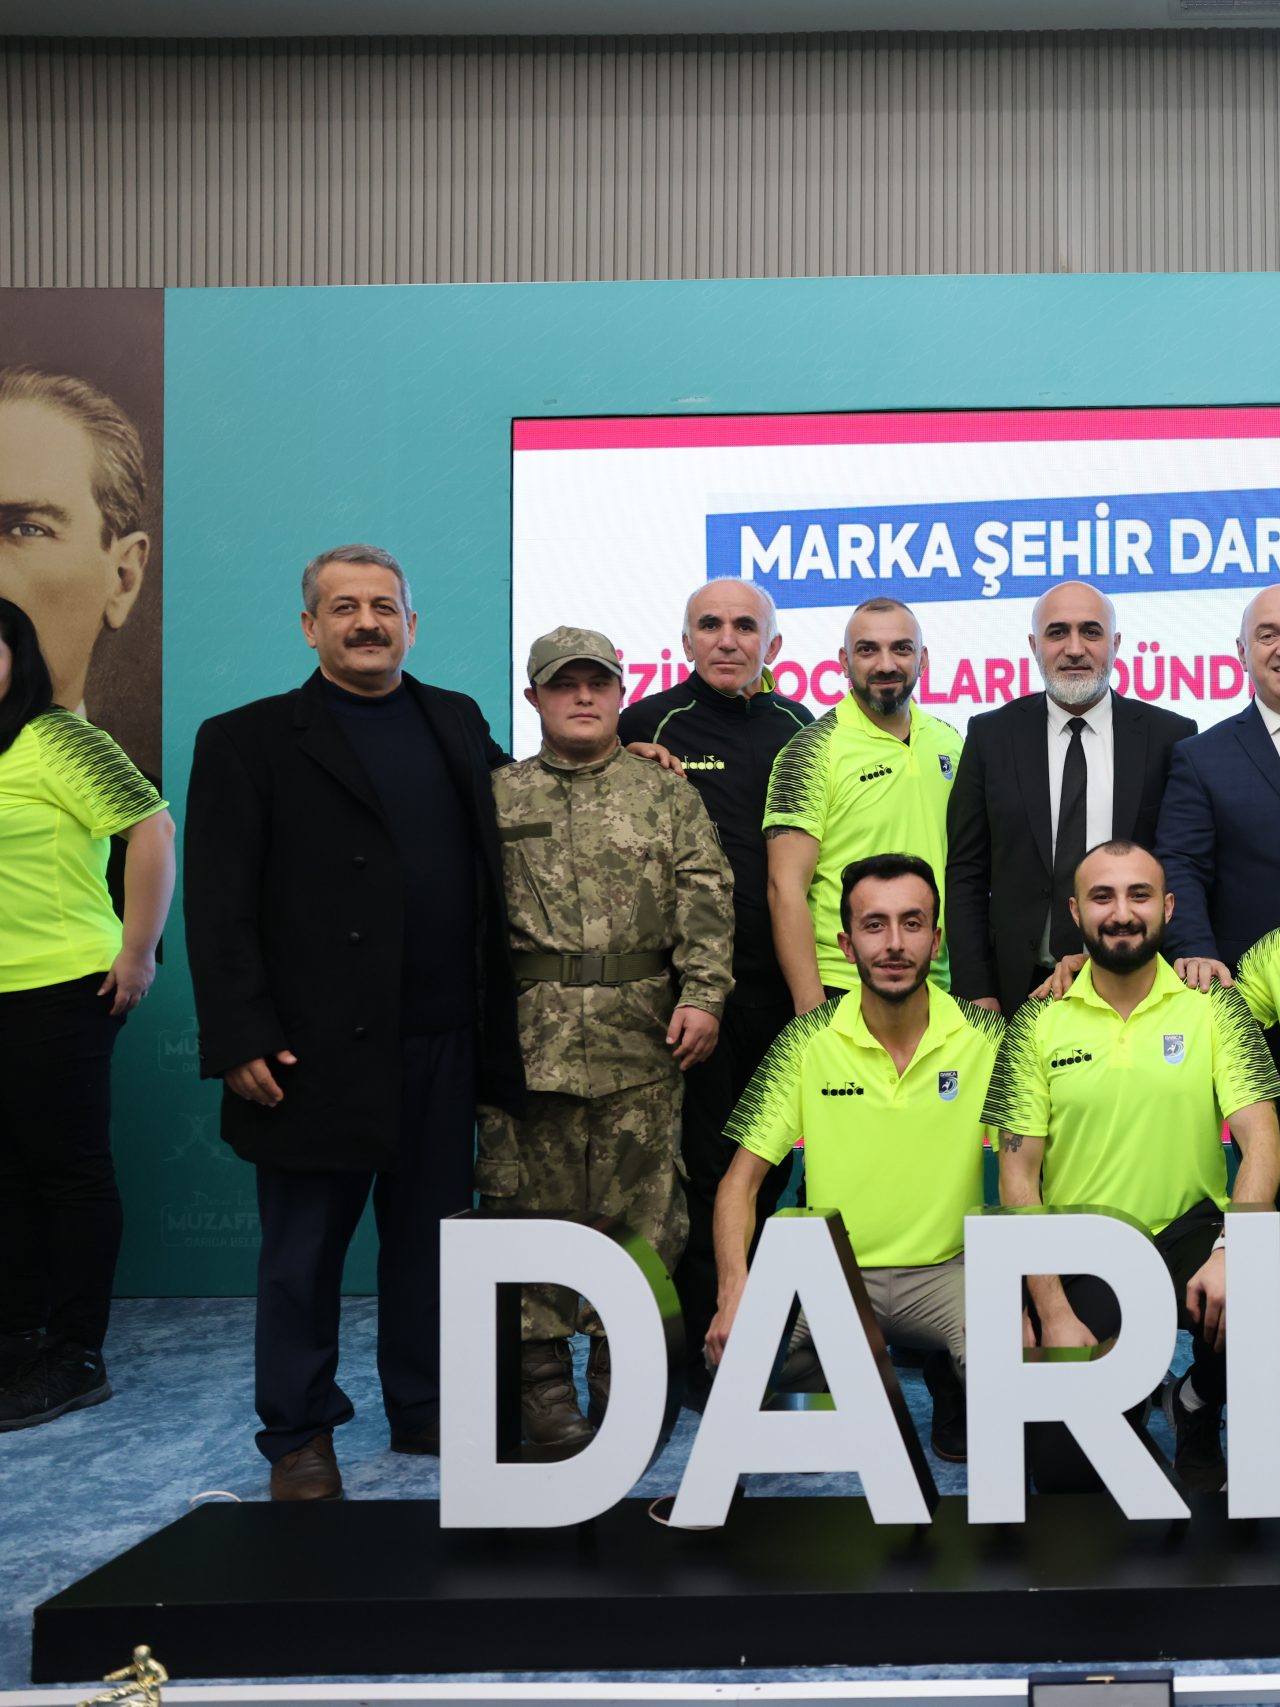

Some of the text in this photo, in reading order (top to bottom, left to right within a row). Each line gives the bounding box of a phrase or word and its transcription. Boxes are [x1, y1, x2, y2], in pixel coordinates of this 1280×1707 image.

[740, 521, 962, 580] MARKA
[972, 502, 1154, 597] ŞEHİR
[860, 764, 893, 782] diadora
[1050, 1049, 1092, 1069] diadora
[821, 1081, 864, 1097] diadora
